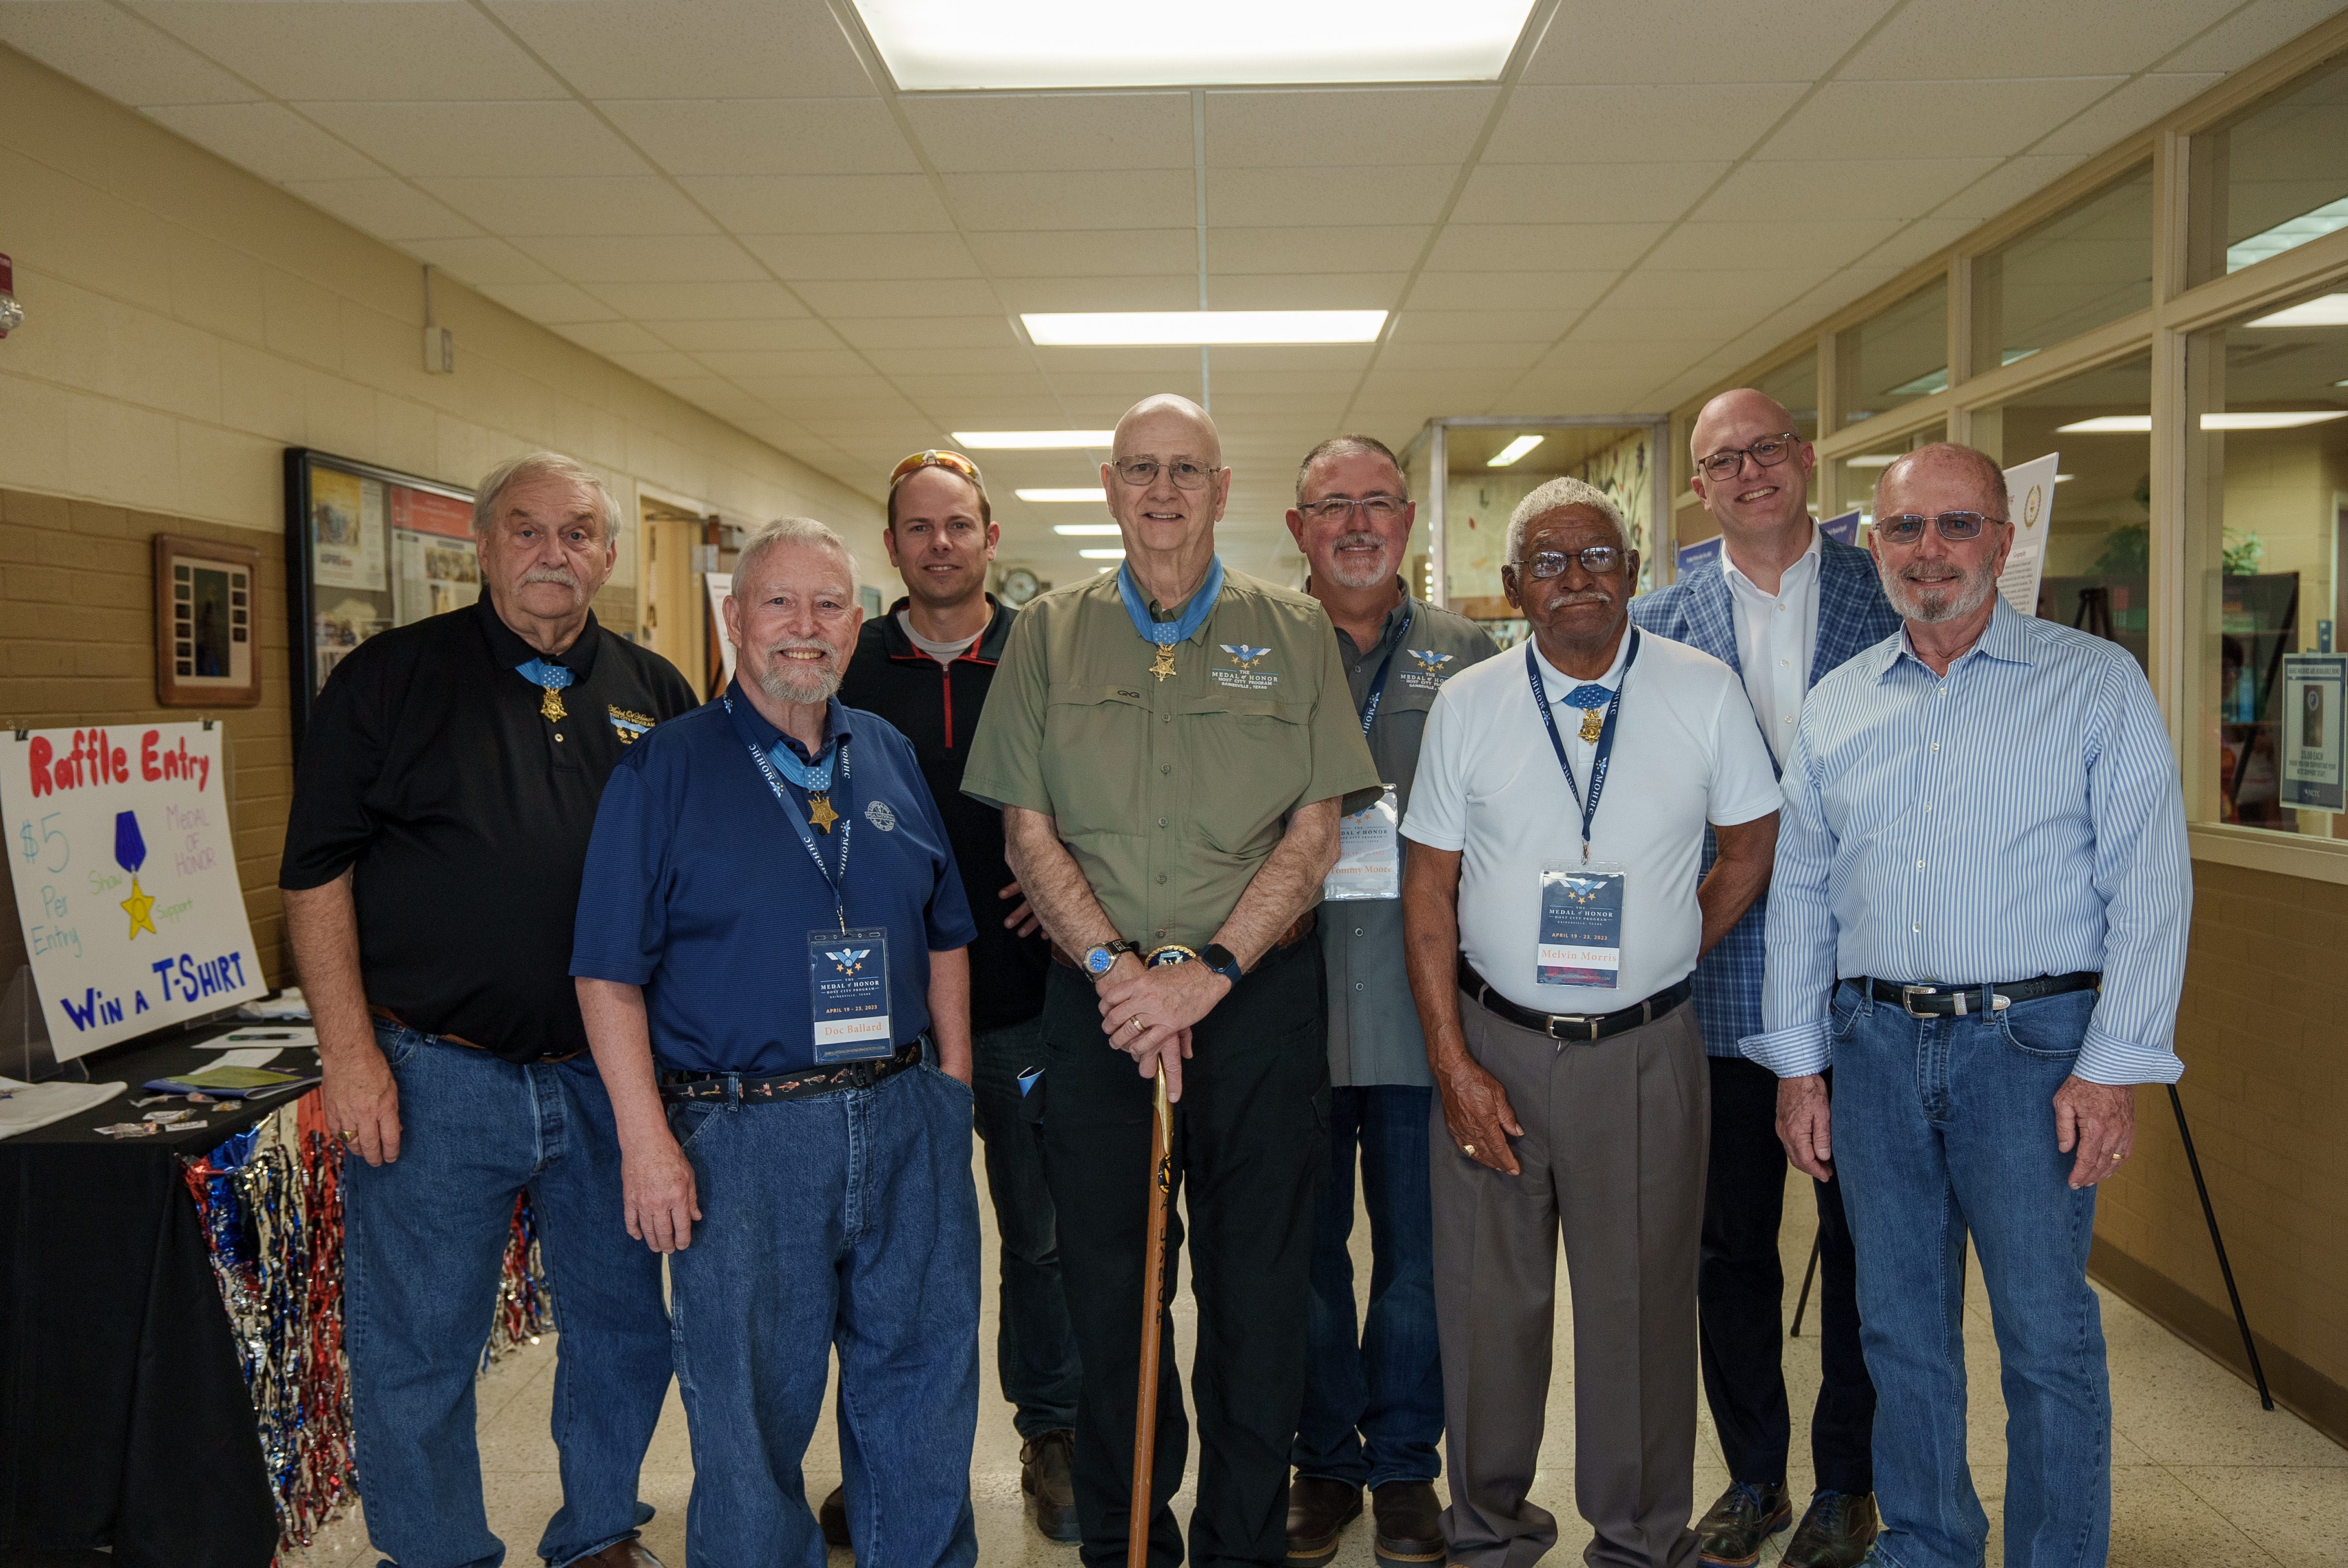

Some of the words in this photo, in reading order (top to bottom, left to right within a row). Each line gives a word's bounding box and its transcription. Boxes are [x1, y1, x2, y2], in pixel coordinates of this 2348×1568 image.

[1530, 674, 1546, 709] MOHHC
[631, 719, 655, 727] PROGRAM
[29, 729, 129, 798] Raffle
[141, 730, 209, 792] Entry
[749, 744, 775, 781] MOHHC
[1589, 775, 1603, 814] MOHHC
[19, 812, 70, 873] $5
[185, 833, 200, 853] OF
[840, 837, 849, 879] MOHHC
[176, 847, 216, 877] HONOR
[1330, 866, 1362, 875] Tommy
[89, 870, 123, 895] Show
[42, 886, 68, 919] Per
[156, 898, 193, 924] Support
[31, 925, 83, 958] Entry
[1542, 950, 1577, 960] Melvin
[1581, 952, 1616, 962] Morris
[152, 952, 246, 1003] T-SHIRT
[825, 1027, 843, 1036] Doc
[847, 1022, 882, 1033] Ballard
